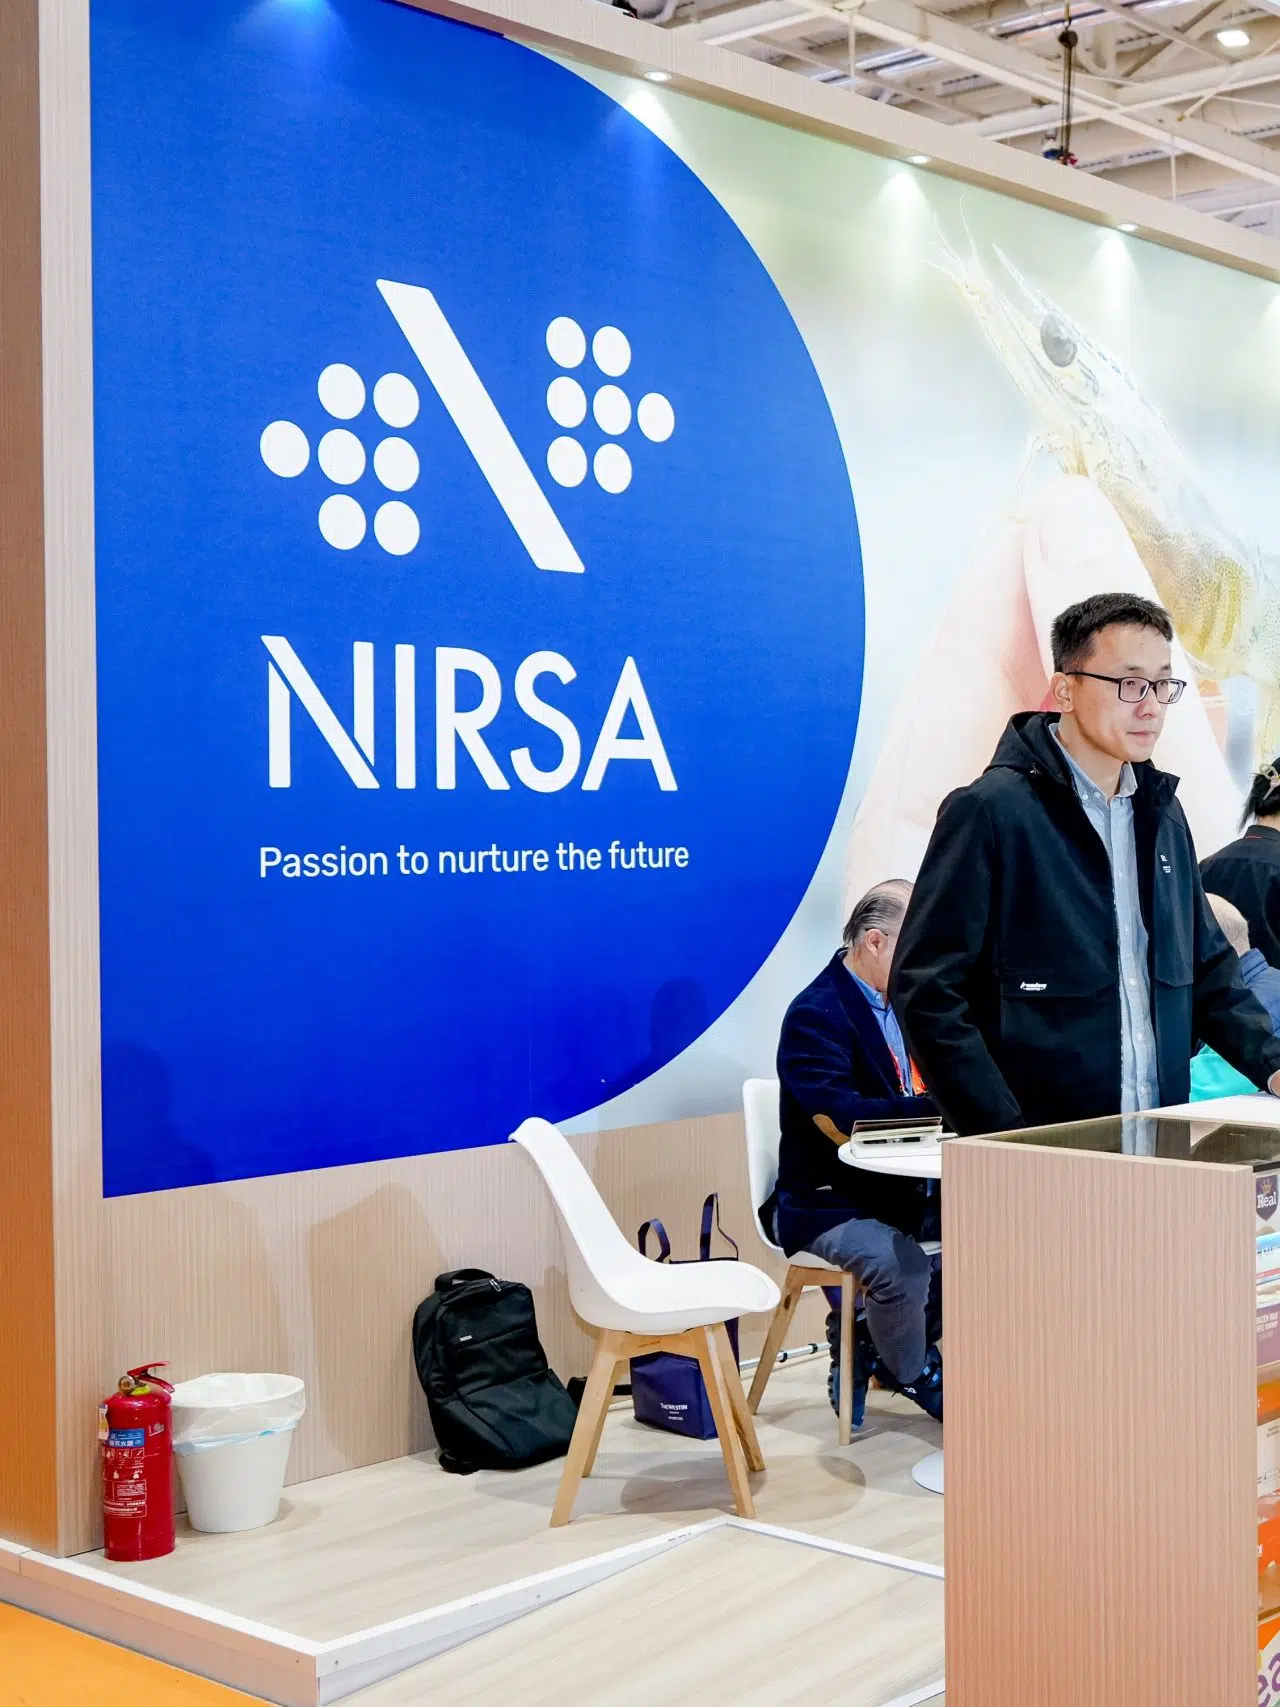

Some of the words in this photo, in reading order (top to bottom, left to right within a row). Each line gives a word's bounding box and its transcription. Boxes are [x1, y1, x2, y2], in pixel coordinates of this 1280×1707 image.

[260, 635, 678, 793] NIRSA
[259, 845, 388, 878] Passion
[397, 844, 429, 875] to
[438, 844, 549, 874] nurture
[556, 842, 602, 870] the
[608, 840, 690, 869] future
[1256, 1191, 1277, 1209] Real
